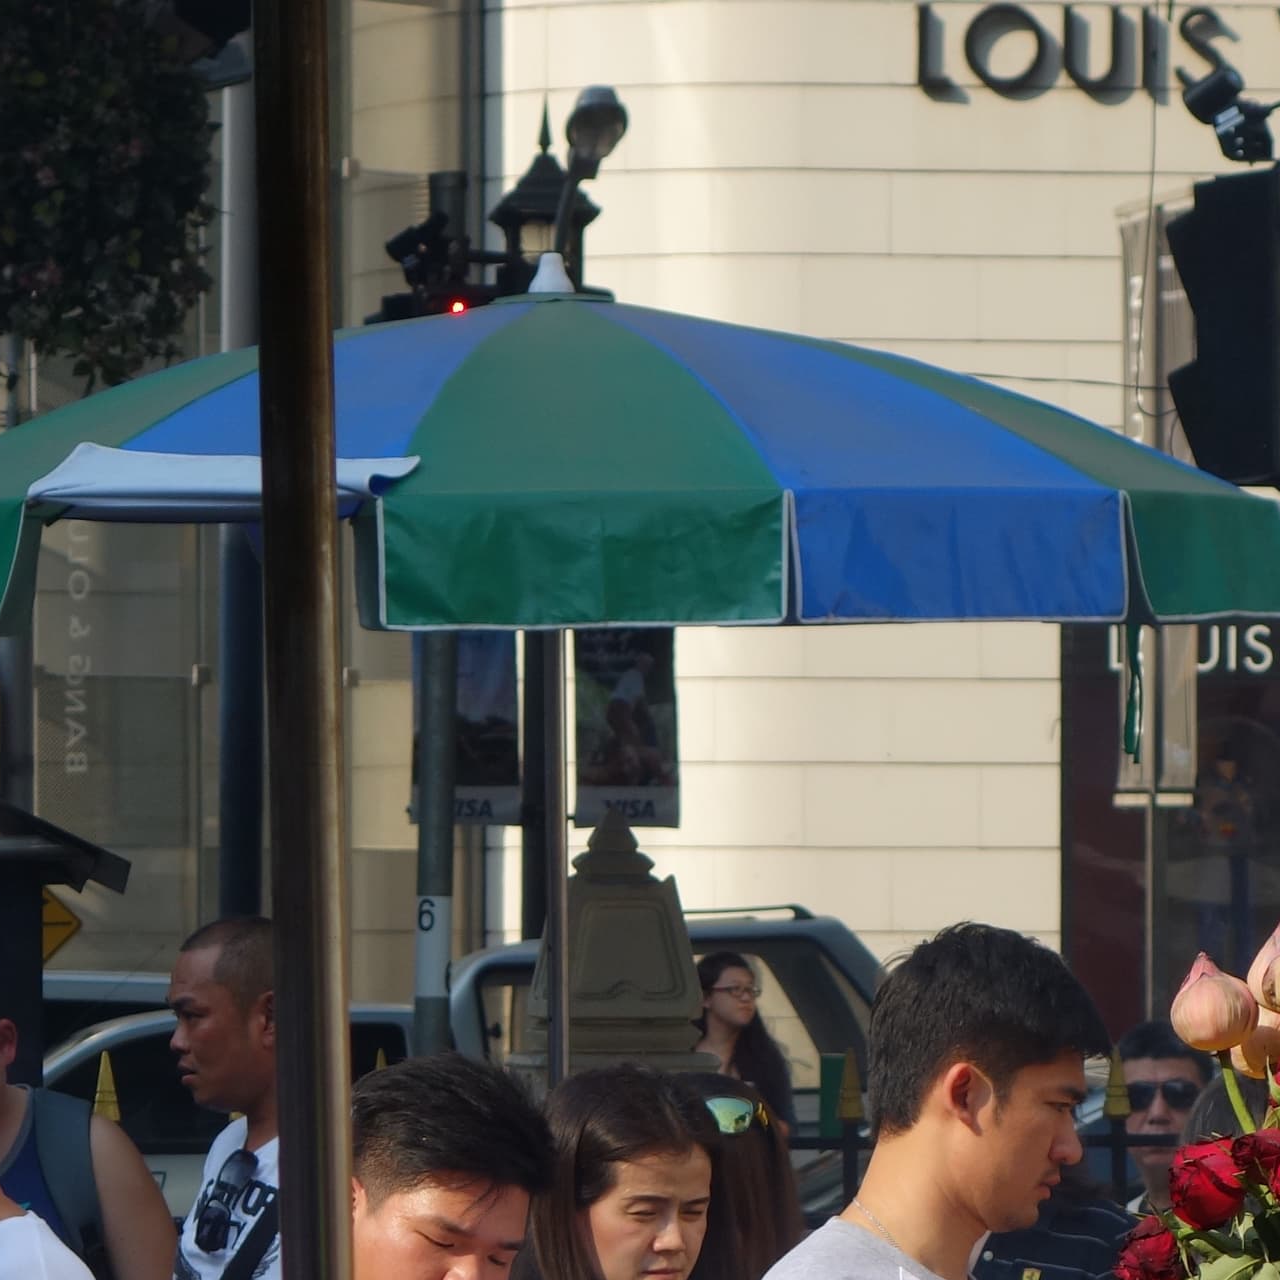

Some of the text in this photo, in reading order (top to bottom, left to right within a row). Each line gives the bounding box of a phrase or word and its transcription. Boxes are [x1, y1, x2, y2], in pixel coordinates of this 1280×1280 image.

[916, 3, 1239, 100] LOUIS
[1109, 624, 1274, 673] LUIS
[418, 898, 436, 932] 6
